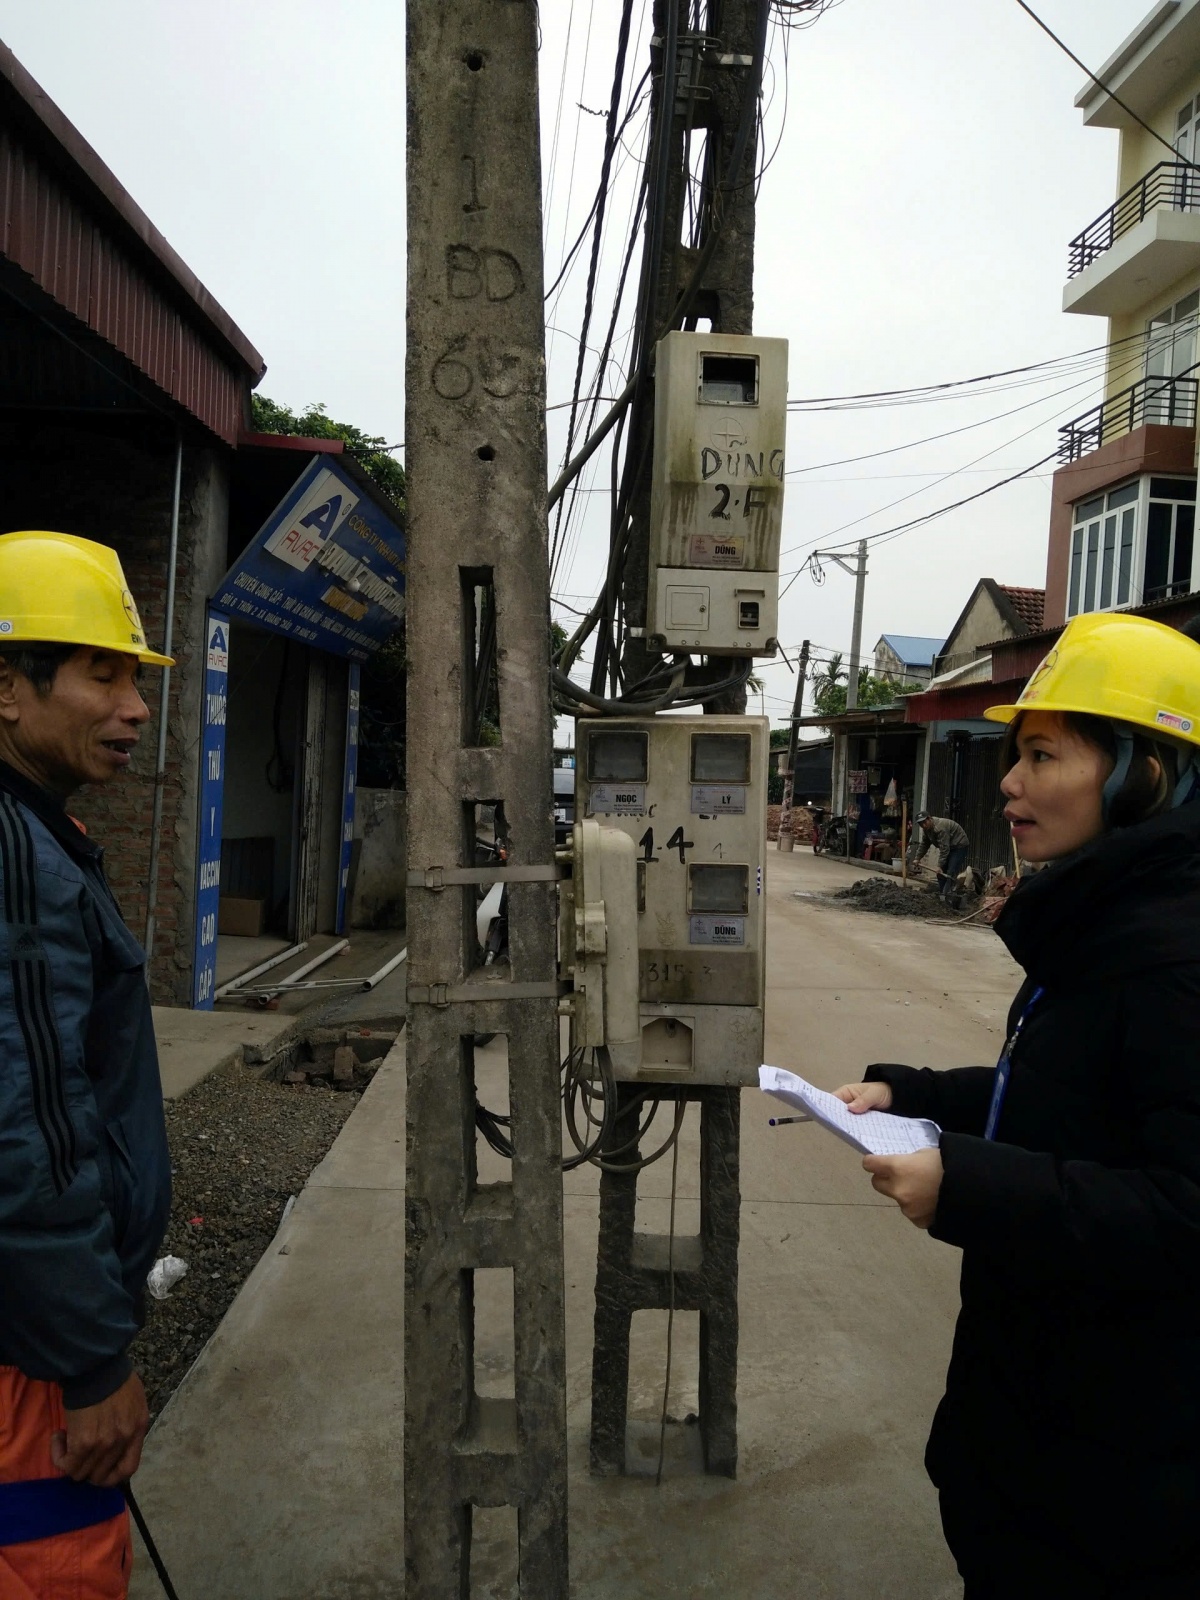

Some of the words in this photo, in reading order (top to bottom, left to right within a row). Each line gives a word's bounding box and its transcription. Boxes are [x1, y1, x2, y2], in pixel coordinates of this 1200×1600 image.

[348, 514, 372, 539] CÔNG
[715, 544, 736, 555] DŨNG
[208, 745, 221, 781] THÚ
[615, 794, 637, 804] NGỌC
[721, 796, 732, 805] LÝ
[714, 925, 736, 936] DŨNG
